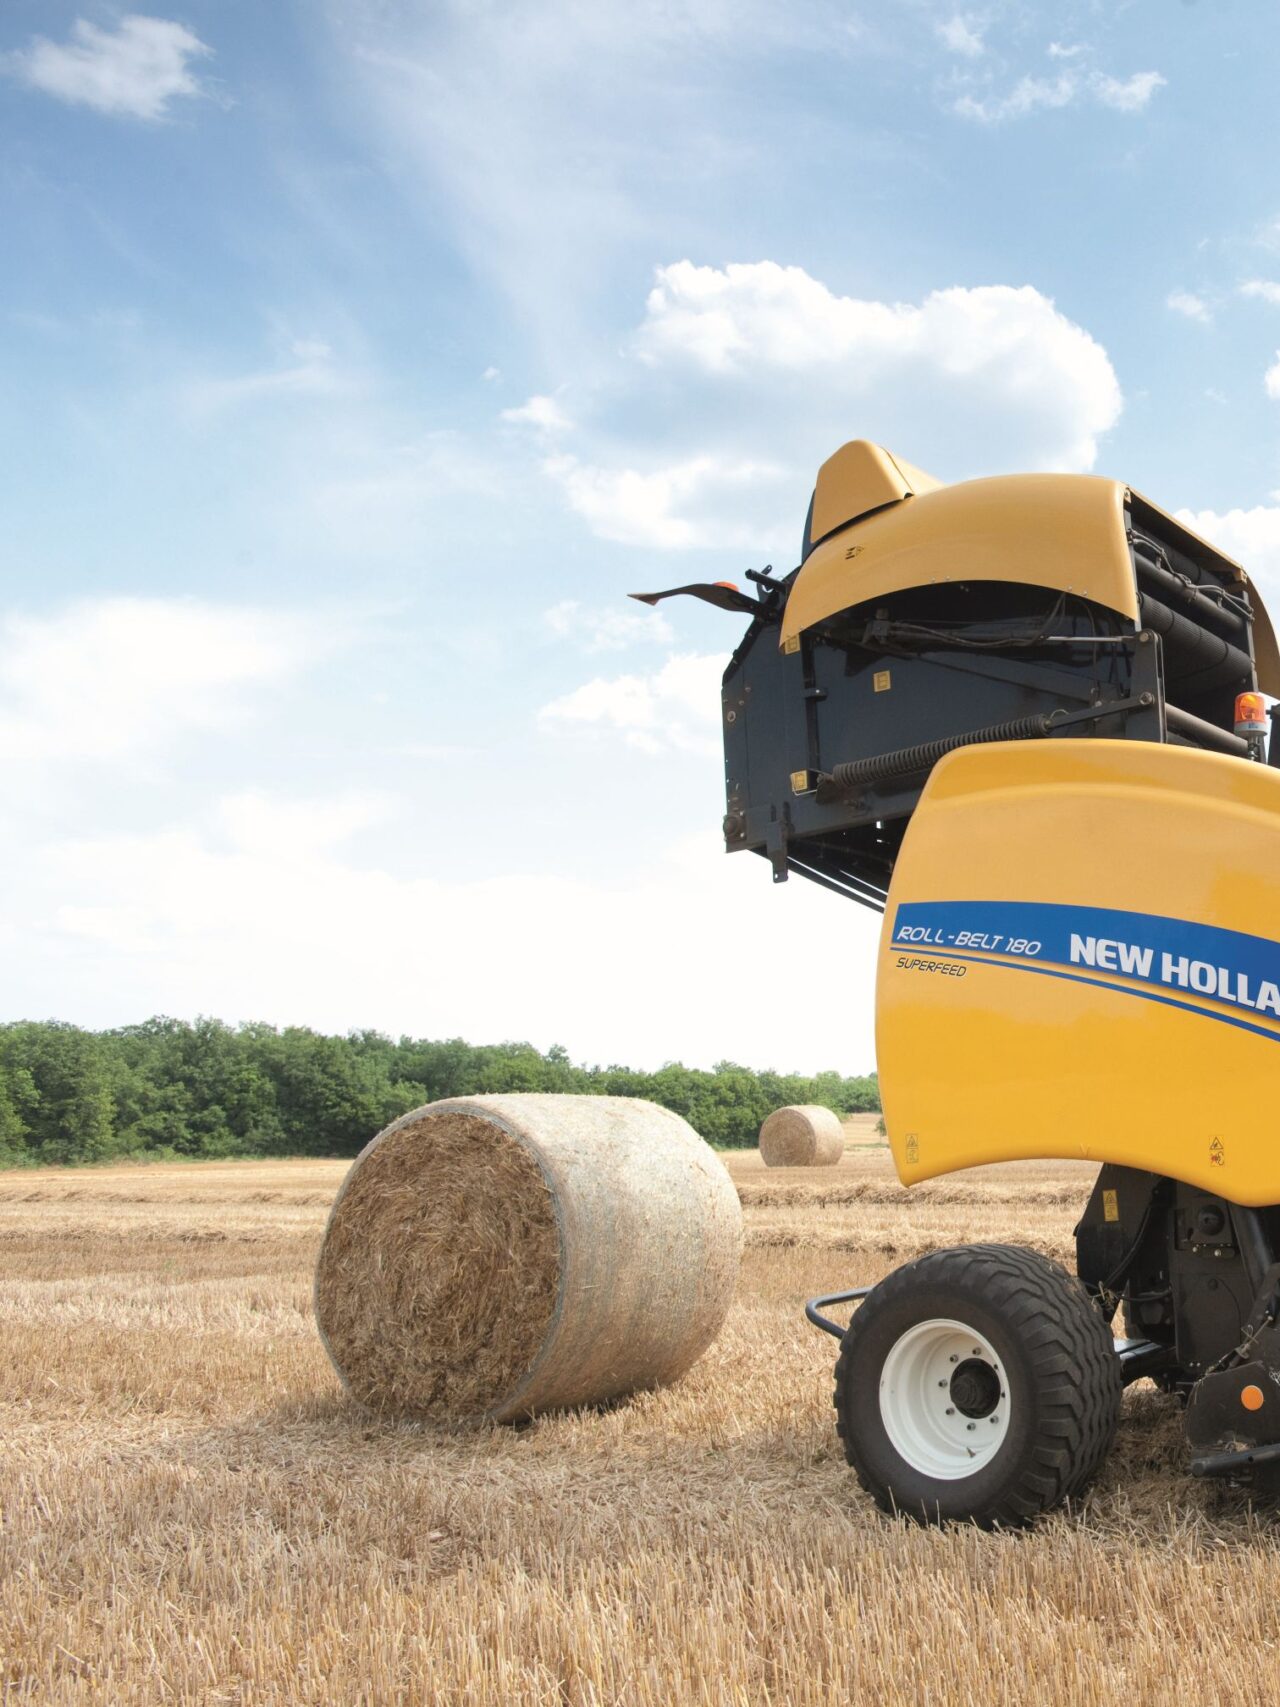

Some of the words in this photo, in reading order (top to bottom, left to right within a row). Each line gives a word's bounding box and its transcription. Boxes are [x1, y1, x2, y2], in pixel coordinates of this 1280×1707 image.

[1005, 937, 1042, 956] 180
[1070, 933, 1154, 978] NEW
[895, 957, 967, 977] SUPERFEED
